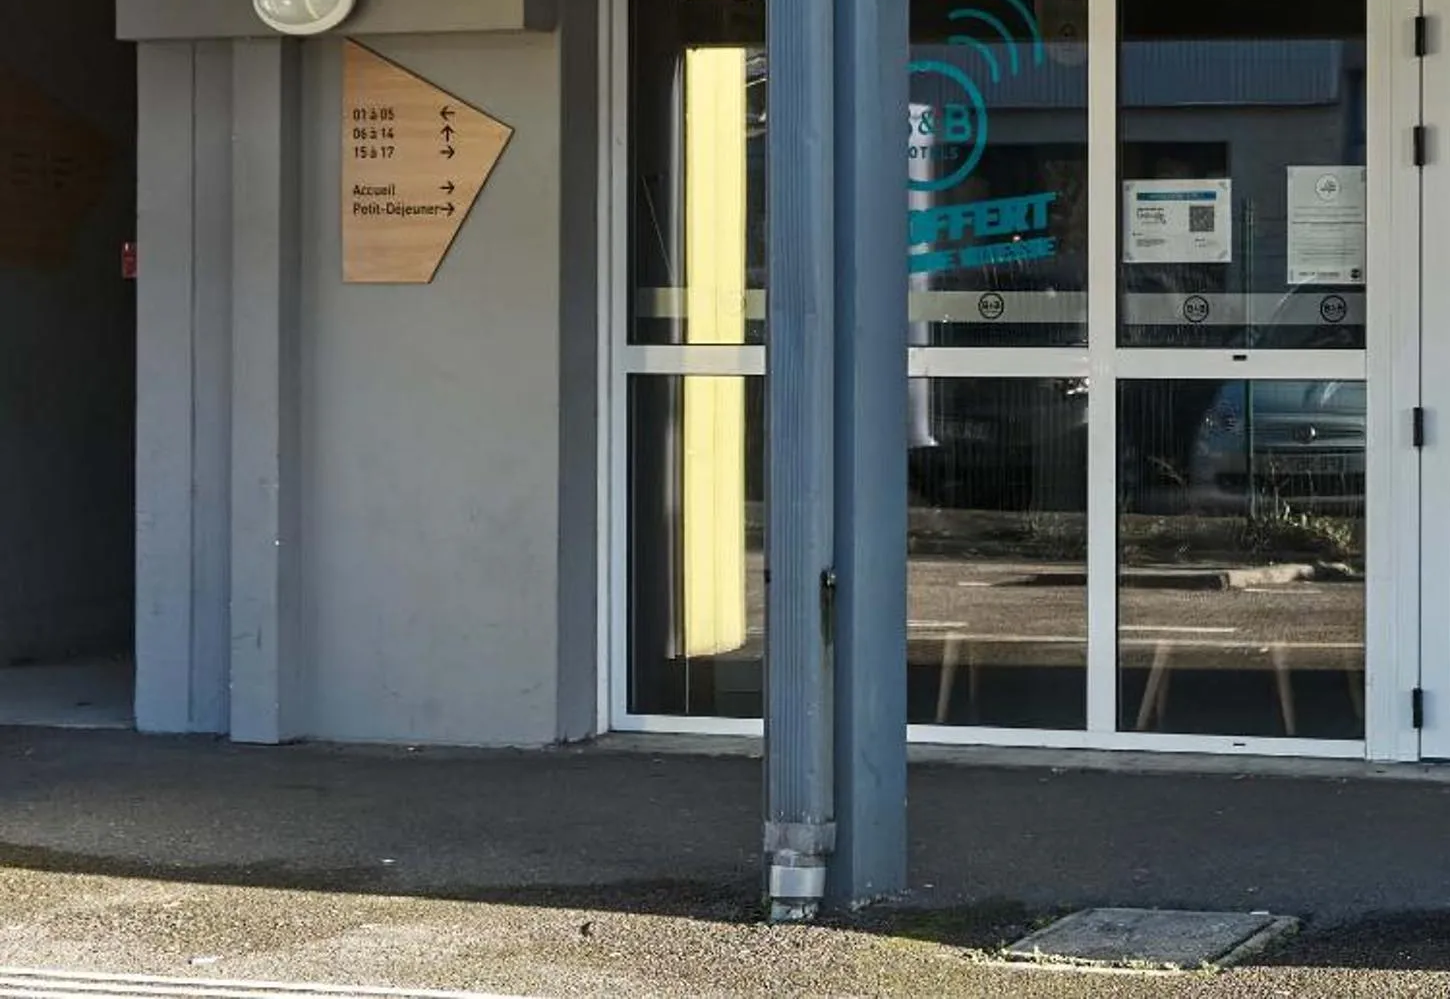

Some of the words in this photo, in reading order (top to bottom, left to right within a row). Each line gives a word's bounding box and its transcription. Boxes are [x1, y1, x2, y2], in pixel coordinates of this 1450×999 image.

[353, 108, 366, 120] 01
[380, 107, 395, 120] 05
[908, 104, 972, 142] &B
[353, 128, 367, 140] 06
[355, 145, 367, 159] 15
[381, 145, 395, 159] 17
[353, 184, 396, 196] Accueil
[353, 202, 440, 217] Petit-Déjeuner
